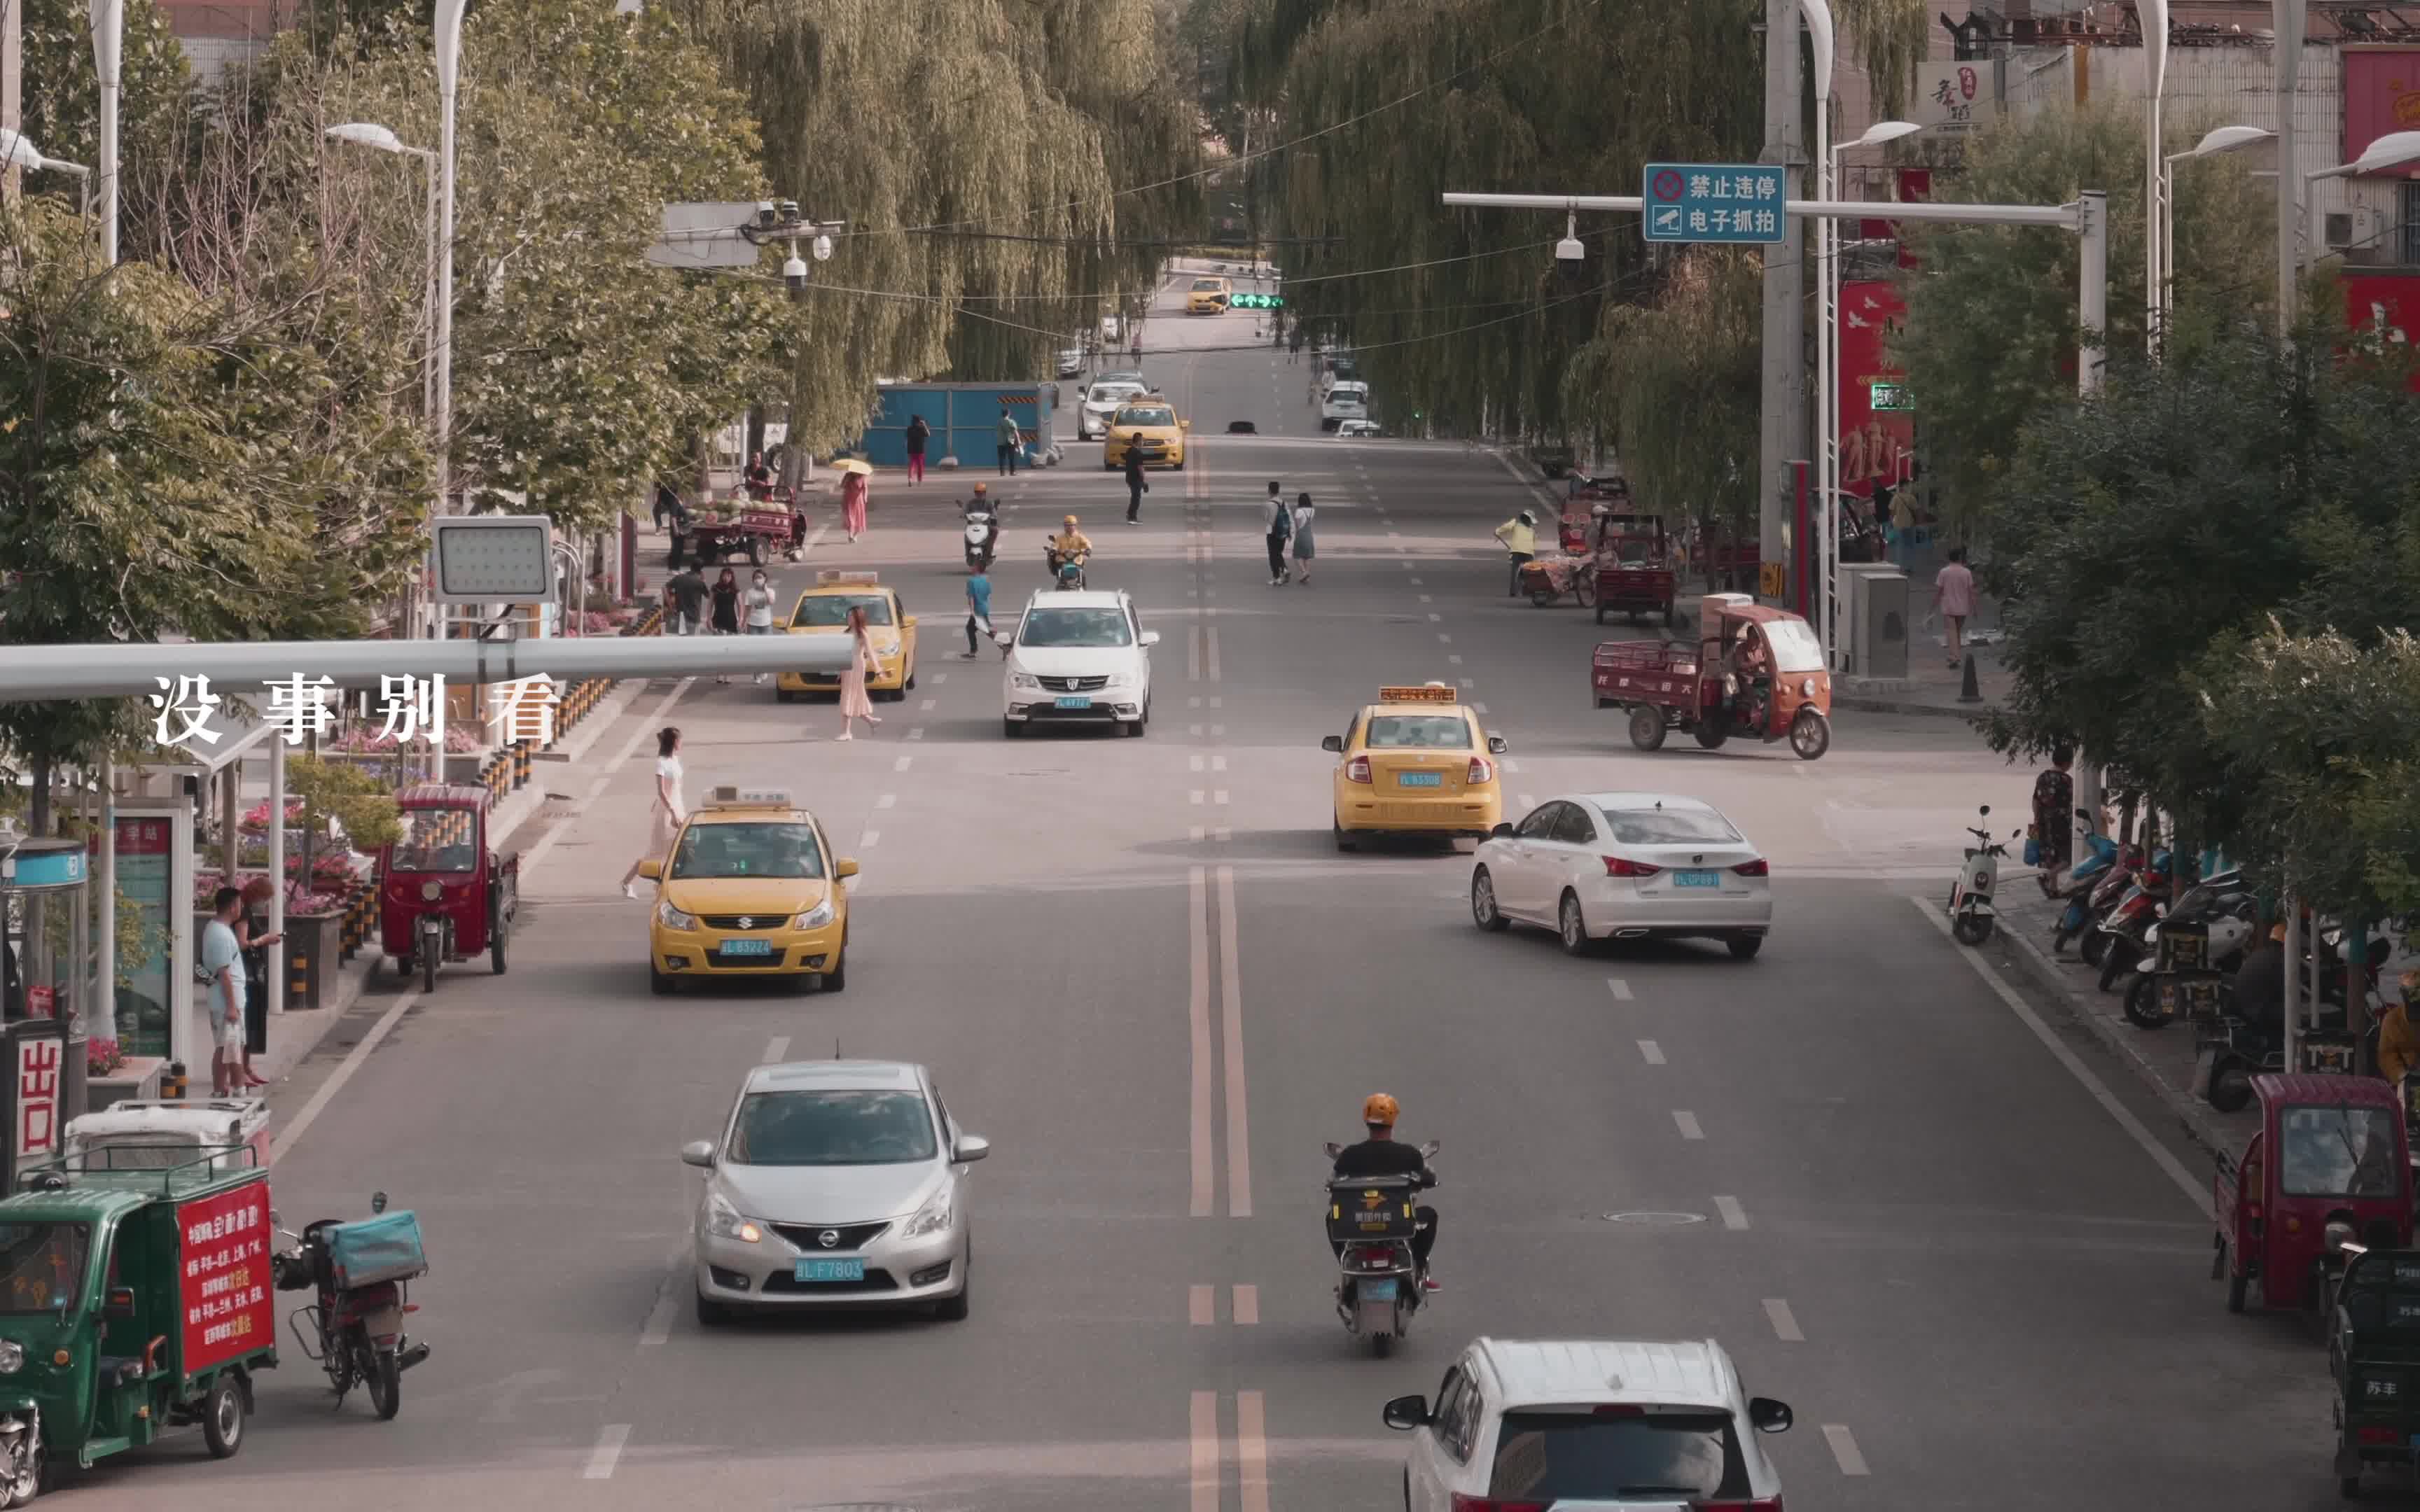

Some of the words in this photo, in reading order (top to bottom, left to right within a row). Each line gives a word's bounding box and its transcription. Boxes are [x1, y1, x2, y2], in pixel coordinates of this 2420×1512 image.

[1690, 174, 1776, 200] 禁止违停
[1690, 209, 1775, 233] 电子抓拍
[22, 1042, 56, 1152] 出口
